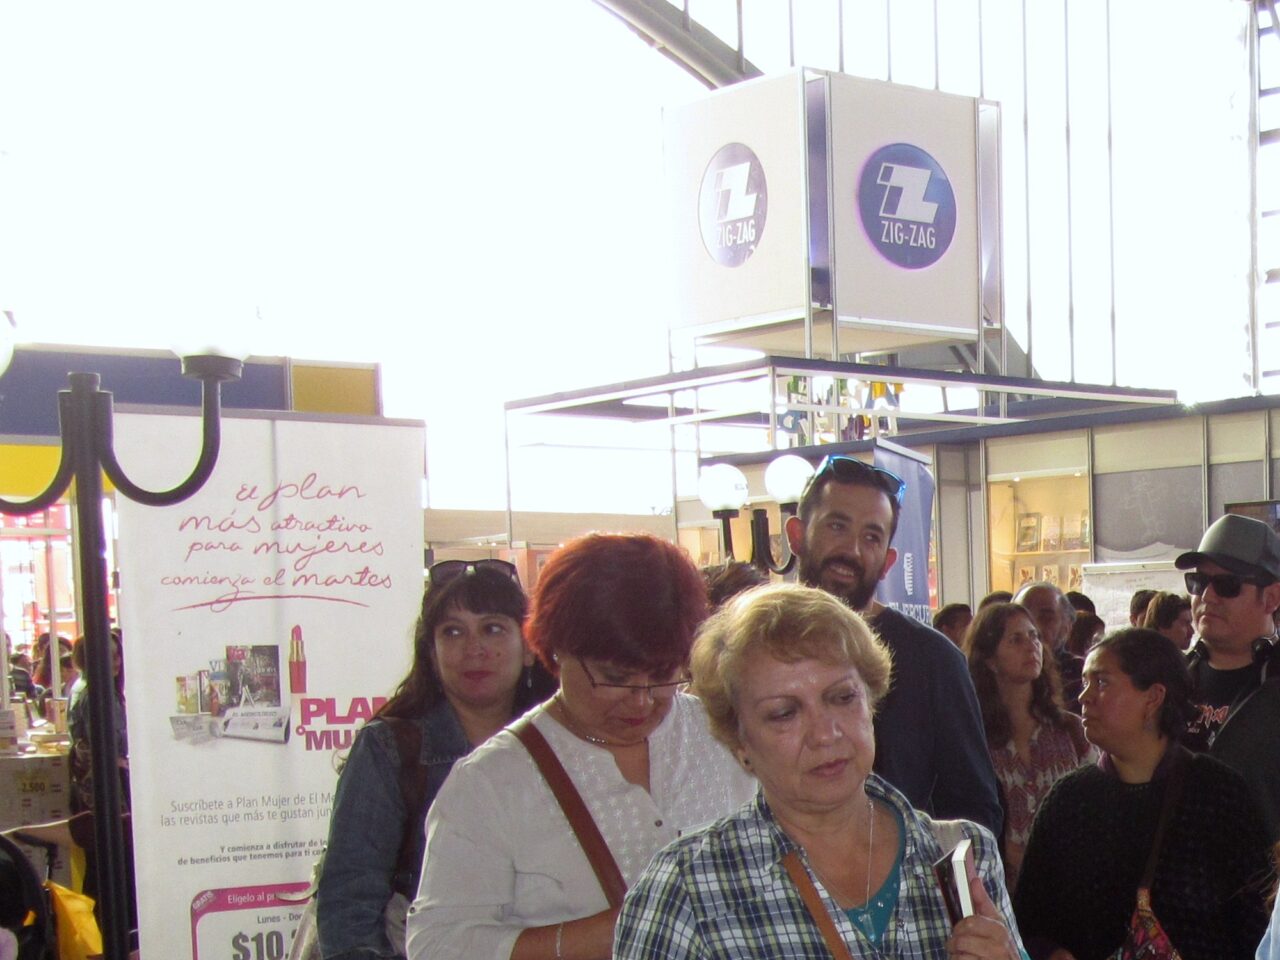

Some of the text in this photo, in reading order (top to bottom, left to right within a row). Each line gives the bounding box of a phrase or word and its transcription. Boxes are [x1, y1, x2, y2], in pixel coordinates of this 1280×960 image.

[716, 219, 756, 248] ZIG-ZAG
[881, 220, 937, 250] ZIG-ZAG
[257, 472, 367, 512] plan
[179, 508, 373, 533] más atractivo
[184, 534, 385, 572] para mujeres
[160, 566, 393, 613] comienza el martes
[227, 801, 233, 810] a
[236, 797, 258, 808] Plan
[261, 795, 290, 810] Mujer
[293, 794, 306, 805] de
[309, 793, 318, 805] El
[161, 815, 176, 827] las
[180, 812, 219, 827] revistas
[222, 813, 240, 825] que
[243, 809, 264, 822] más
[267, 809, 277, 820] te
[280, 807, 314, 823] gustan
[227, 842, 264, 853] comienza
[273, 840, 306, 850] disfrutar
[308, 839, 318, 847] de
[178, 858, 188, 866] de
[190, 854, 231, 865] beneficios
[233, 854, 247, 863] que
[250, 852, 283, 861] tenemos
[285, 851, 302, 860] para
[257, 892, 265, 901] al
[257, 914, 281, 924] Lunes
